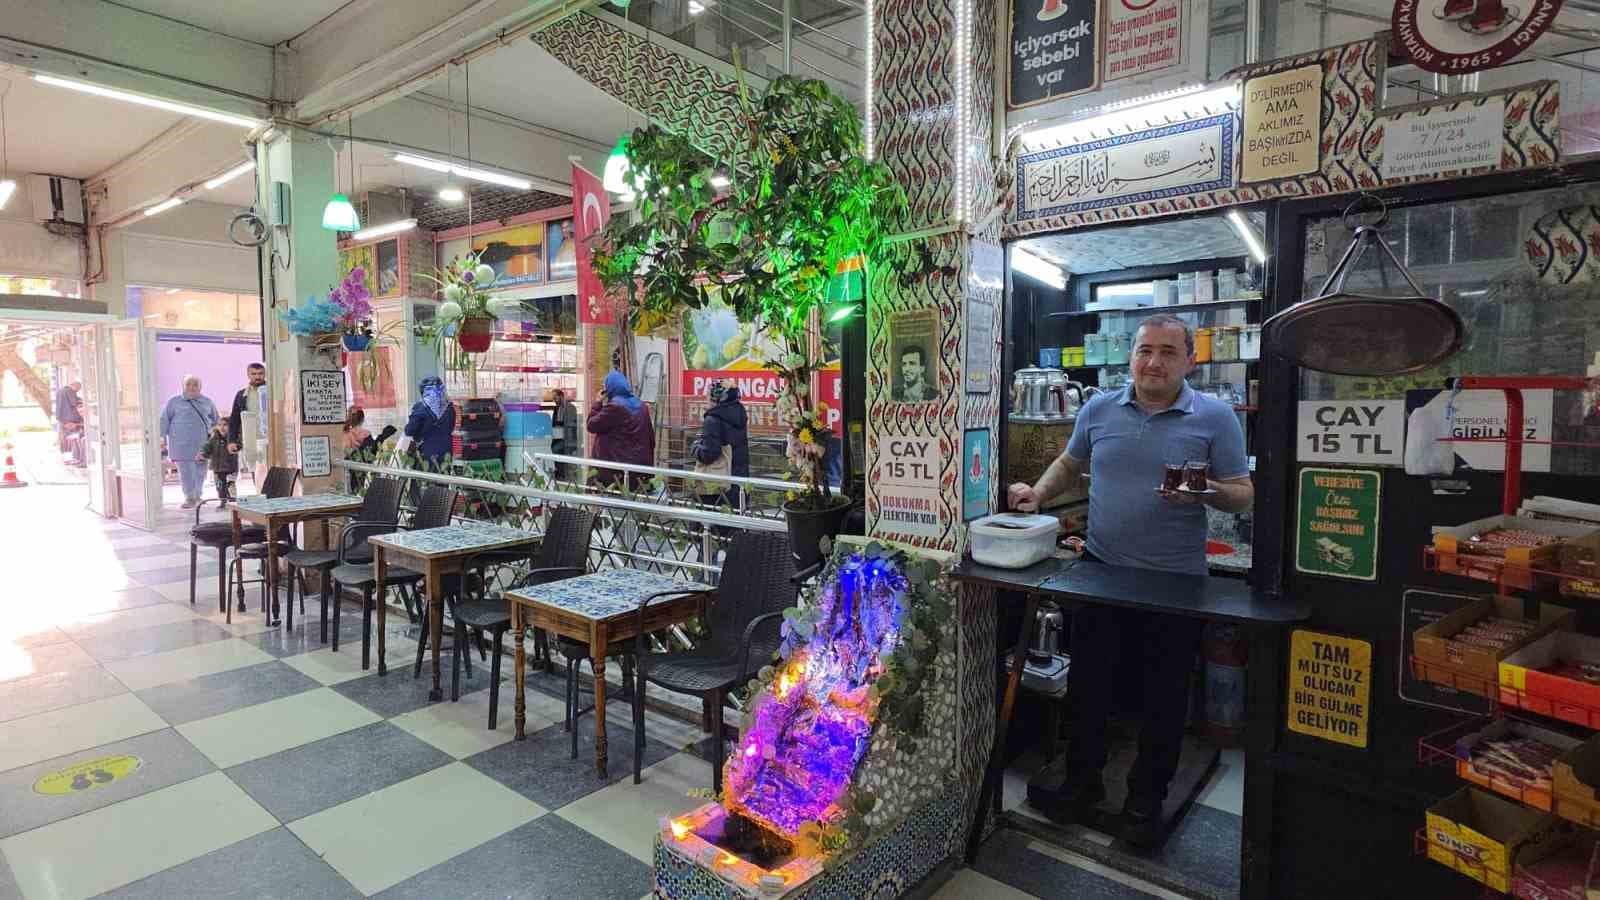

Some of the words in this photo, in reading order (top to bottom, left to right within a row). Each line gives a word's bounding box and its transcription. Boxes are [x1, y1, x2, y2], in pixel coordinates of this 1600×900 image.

[1512, 0, 1554, 46] ANLIĞI
[1023, 41, 1080, 71] sebebi
[1450, 53, 1491, 69] 1965
[1036, 69, 1065, 86] var
[1265, 97, 1298, 114] AMA
[1257, 114, 1304, 132] AKLIMIZ
[1248, 129, 1313, 152] BAŞIMIZDA
[1421, 133, 1429, 145] 7
[1446, 127, 1465, 141] 24
[1262, 151, 1299, 168] DEĞİL
[1316, 405, 1385, 432] ÇAY
[890, 440, 929, 461] ÇAY
[1306, 433, 1341, 453] 15
[1350, 434, 1393, 455] TL
[885, 461, 905, 478] 15
[910, 463, 934, 480] TL
[882, 495, 931, 512] DOKUNMA
[883, 510, 919, 524] ELEKTRİK
[921, 513, 937, 525] VAR
[1312, 641, 1350, 665] TAM
[1298, 659, 1363, 684] MUTSUZ
[1295, 691, 1315, 707] BİR
[1297, 710, 1359, 737] GELİYOR
